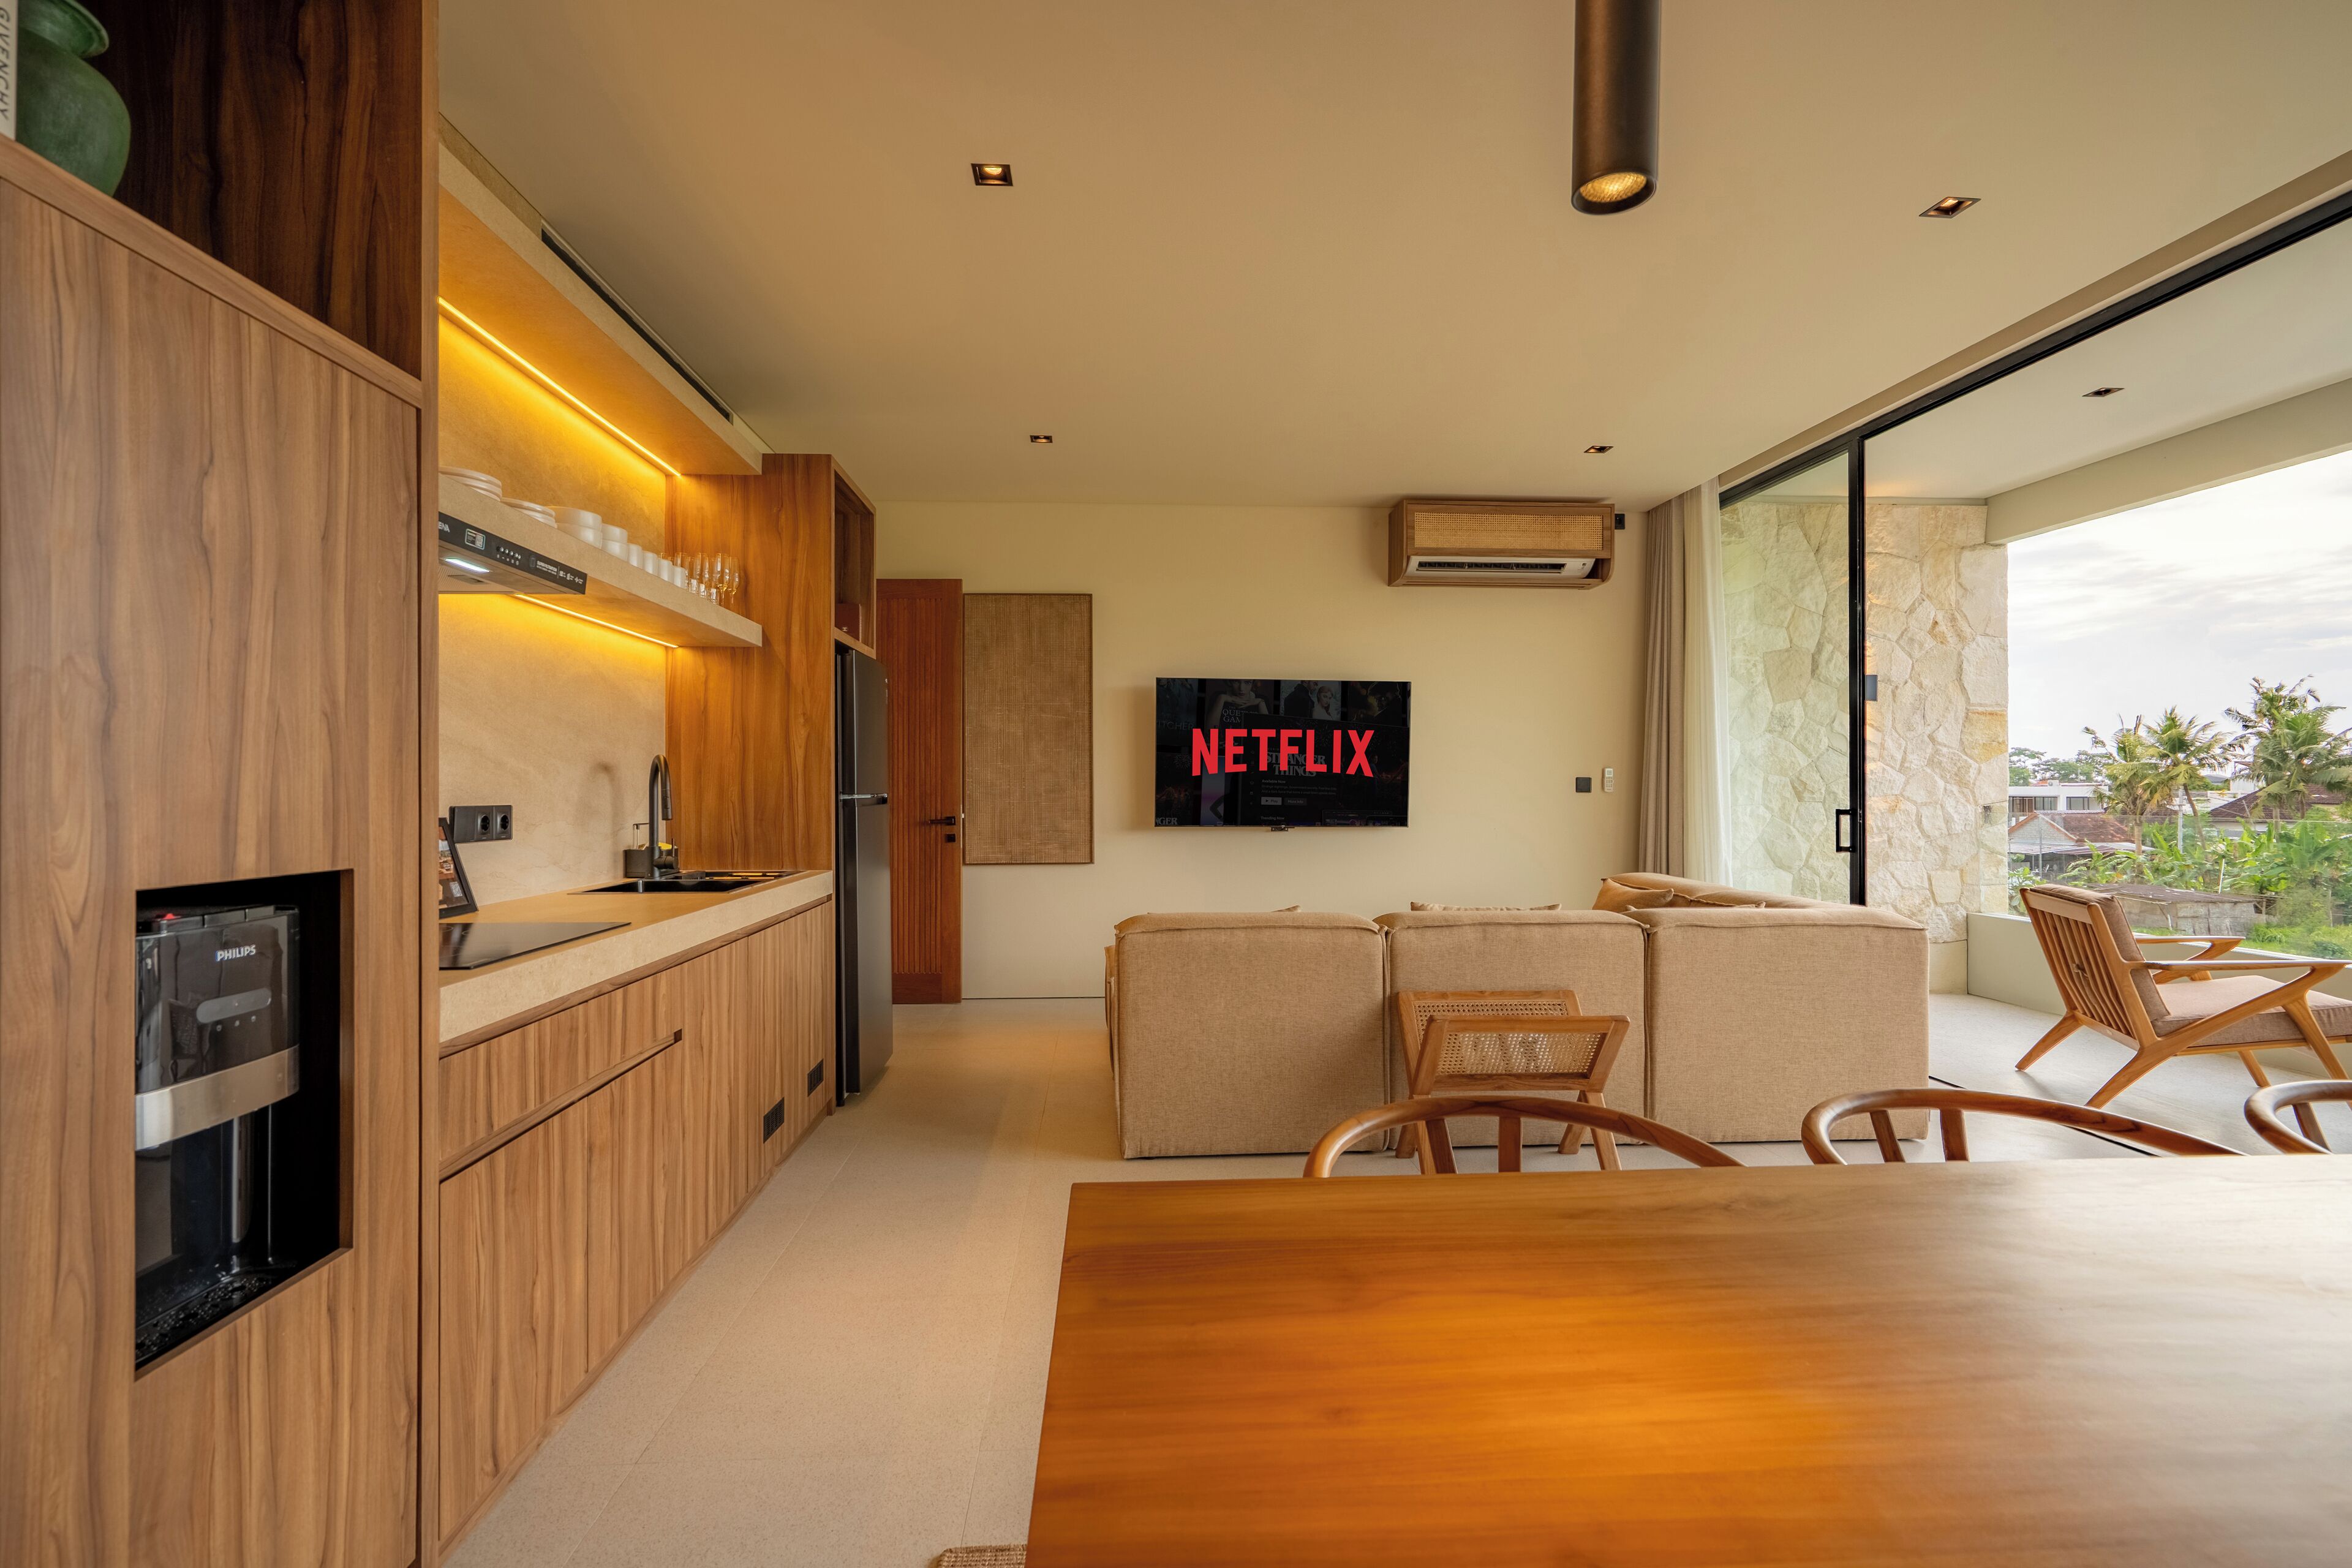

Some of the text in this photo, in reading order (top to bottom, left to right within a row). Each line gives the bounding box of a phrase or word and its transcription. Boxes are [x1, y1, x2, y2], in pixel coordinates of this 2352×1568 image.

[0, 7, 10, 121] GIVENCHY
[1192, 728, 1374, 777] NETFLIX
[216, 944, 256, 962] PHILIPS
